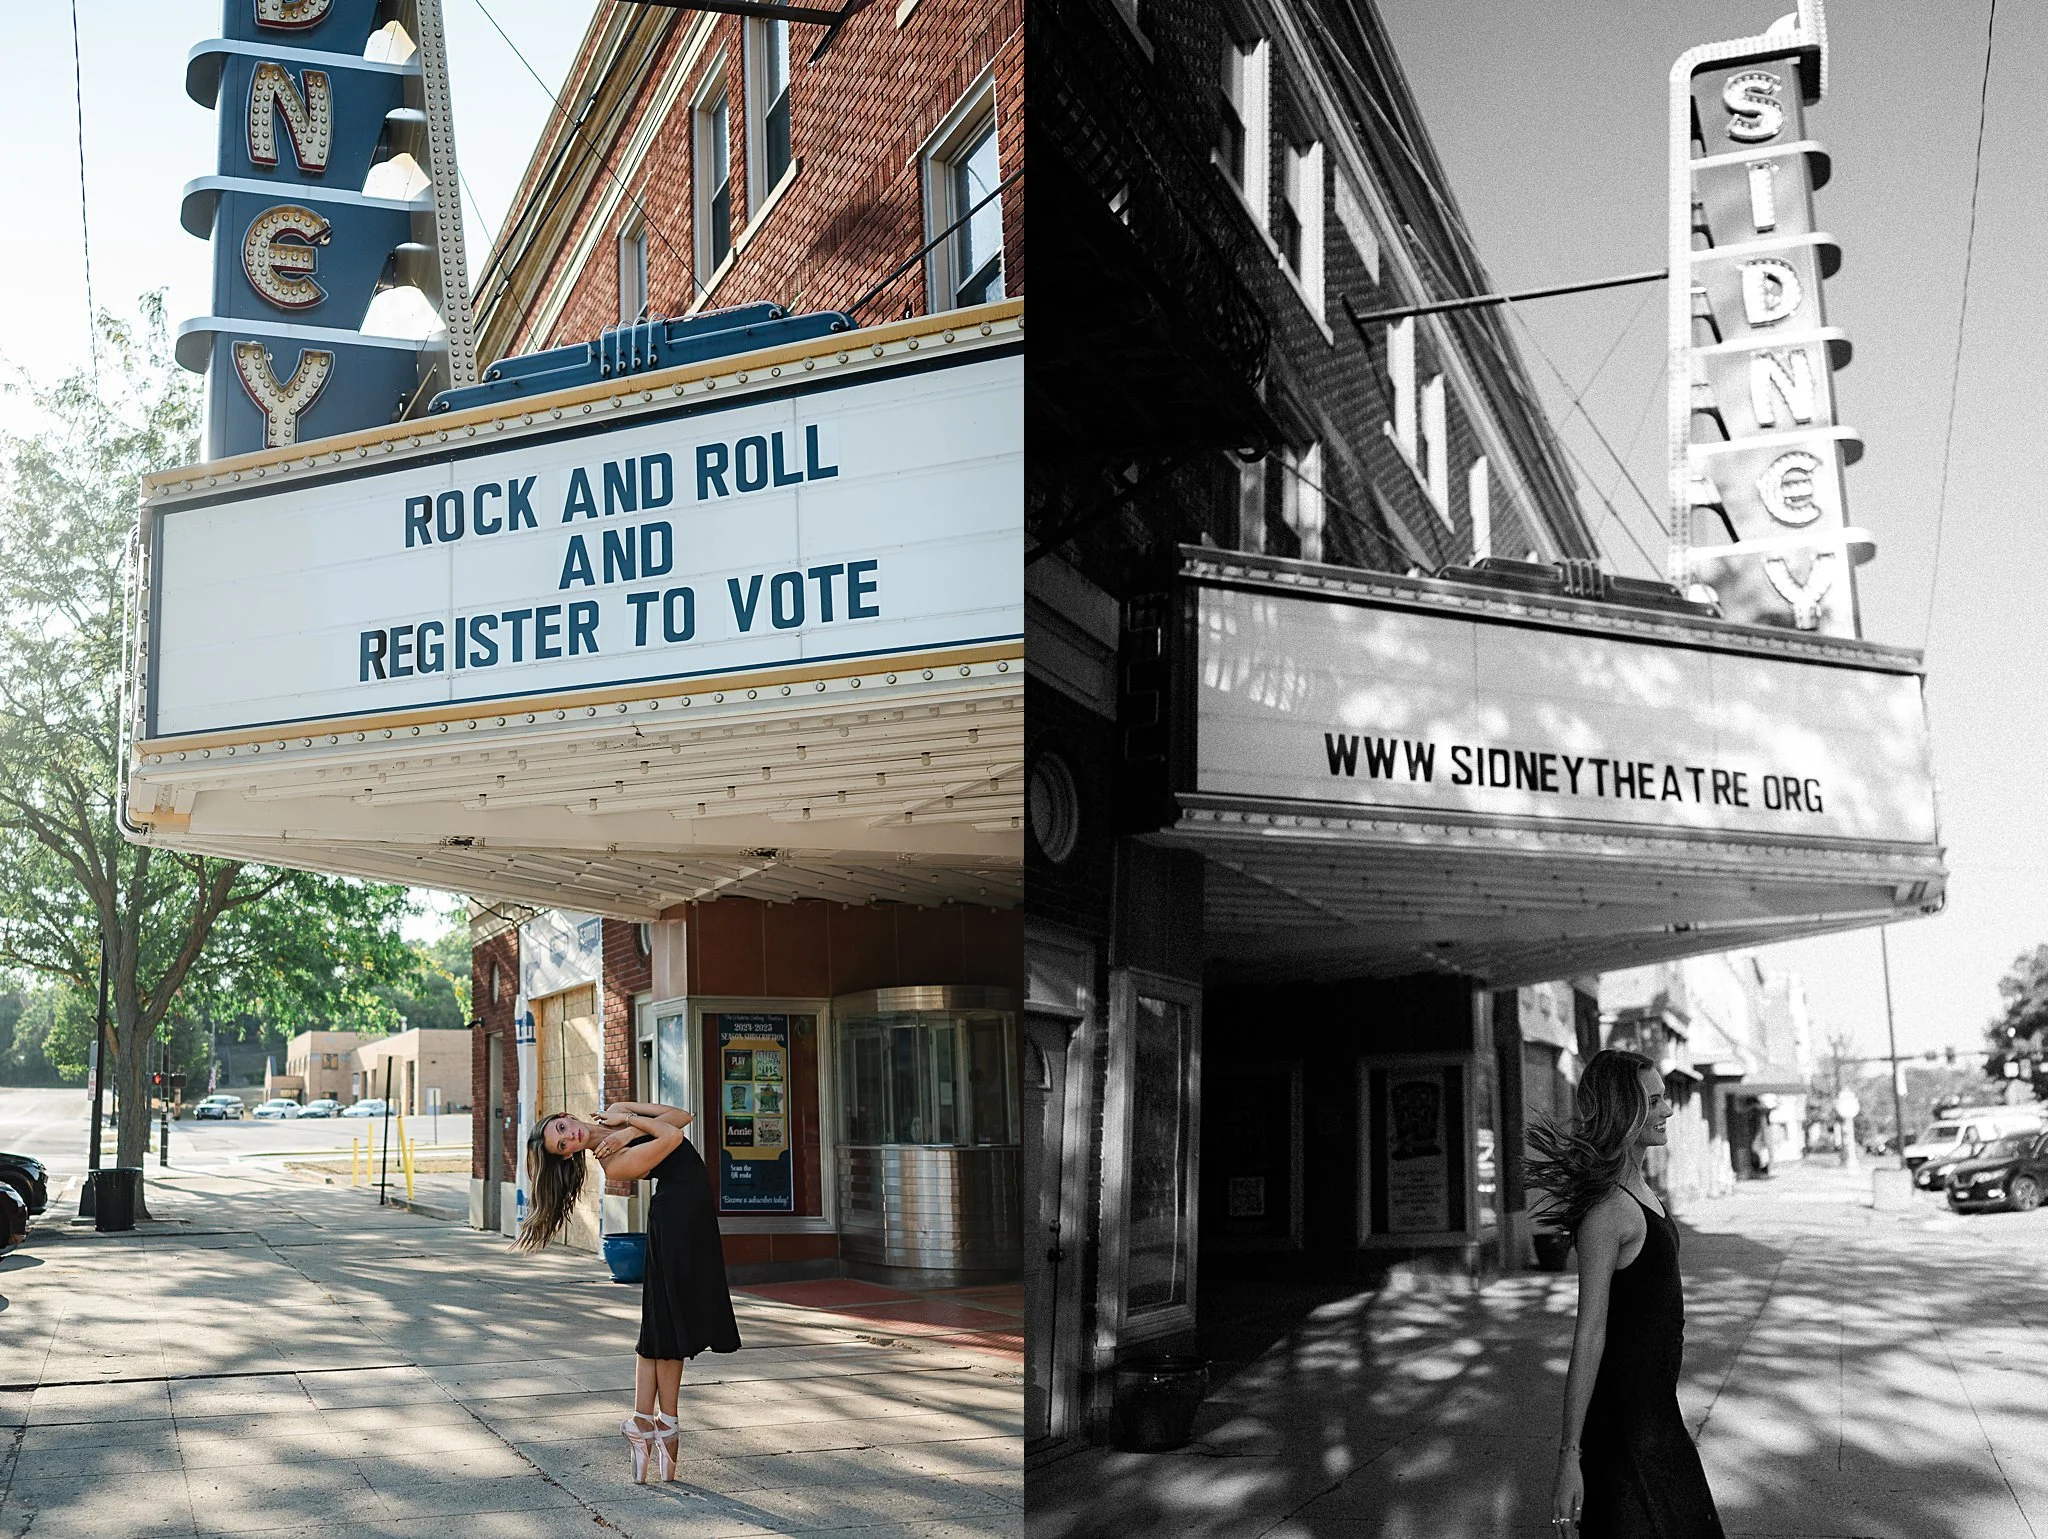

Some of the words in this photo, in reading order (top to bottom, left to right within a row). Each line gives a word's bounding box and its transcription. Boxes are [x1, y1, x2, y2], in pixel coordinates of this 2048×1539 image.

[231, 0, 335, 449] NEY
[1722, 70, 1836, 631] SIDNEY
[405, 475, 538, 548] ROCK
[561, 452, 673, 524] AND
[695, 424, 839, 501] ROLL
[558, 521, 673, 590] AND
[359, 600, 600, 682] REGISTER
[626, 586, 696, 647] TO
[727, 559, 880, 633] VOTE
[1324, 733, 1436, 782] WWW
[1451, 745, 1750, 808] SIDNEYTHEATRE
[1763, 774, 1824, 814] ORG
[720, 1032, 743, 1041] SEASON
[744, 1033, 785, 1042] SUBSCRIPTION
[731, 1056, 746, 1066] PLAY
[727, 1125, 753, 1136] Annie
[730, 1164, 743, 1172] Scan
[743, 1164, 752, 1172] the
